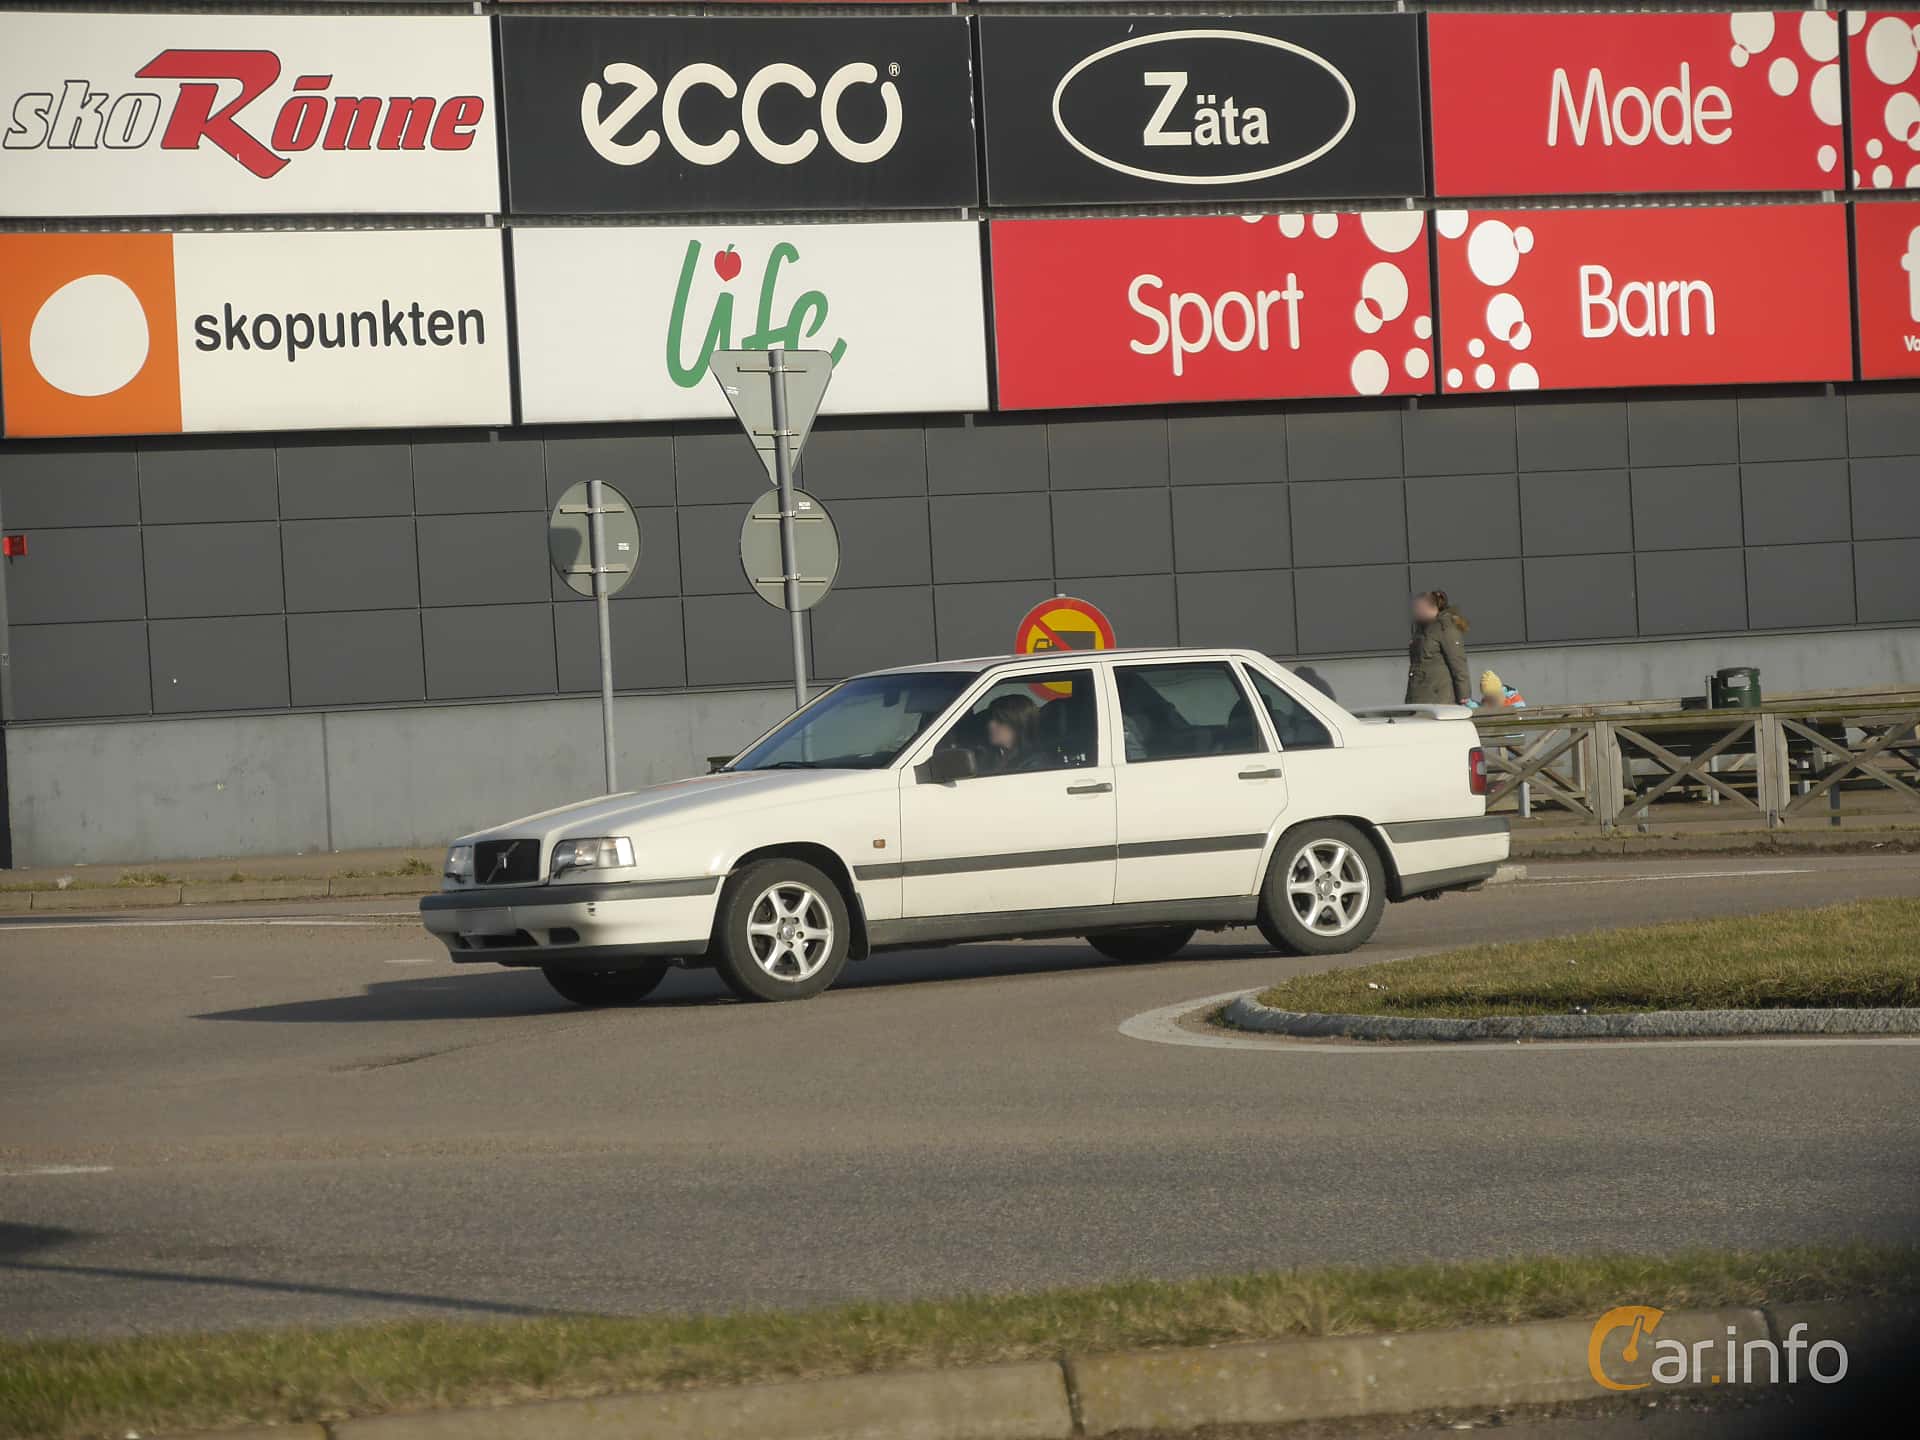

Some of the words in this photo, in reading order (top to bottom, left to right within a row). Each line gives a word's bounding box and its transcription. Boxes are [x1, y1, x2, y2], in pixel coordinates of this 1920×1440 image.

[1143, 71, 1270, 146] Zäta
[1547, 62, 1733, 146] Mode
[195, 300, 485, 362] skopunkten
[1128, 273, 1305, 376] Sport
[1579, 264, 1716, 339] Barn
